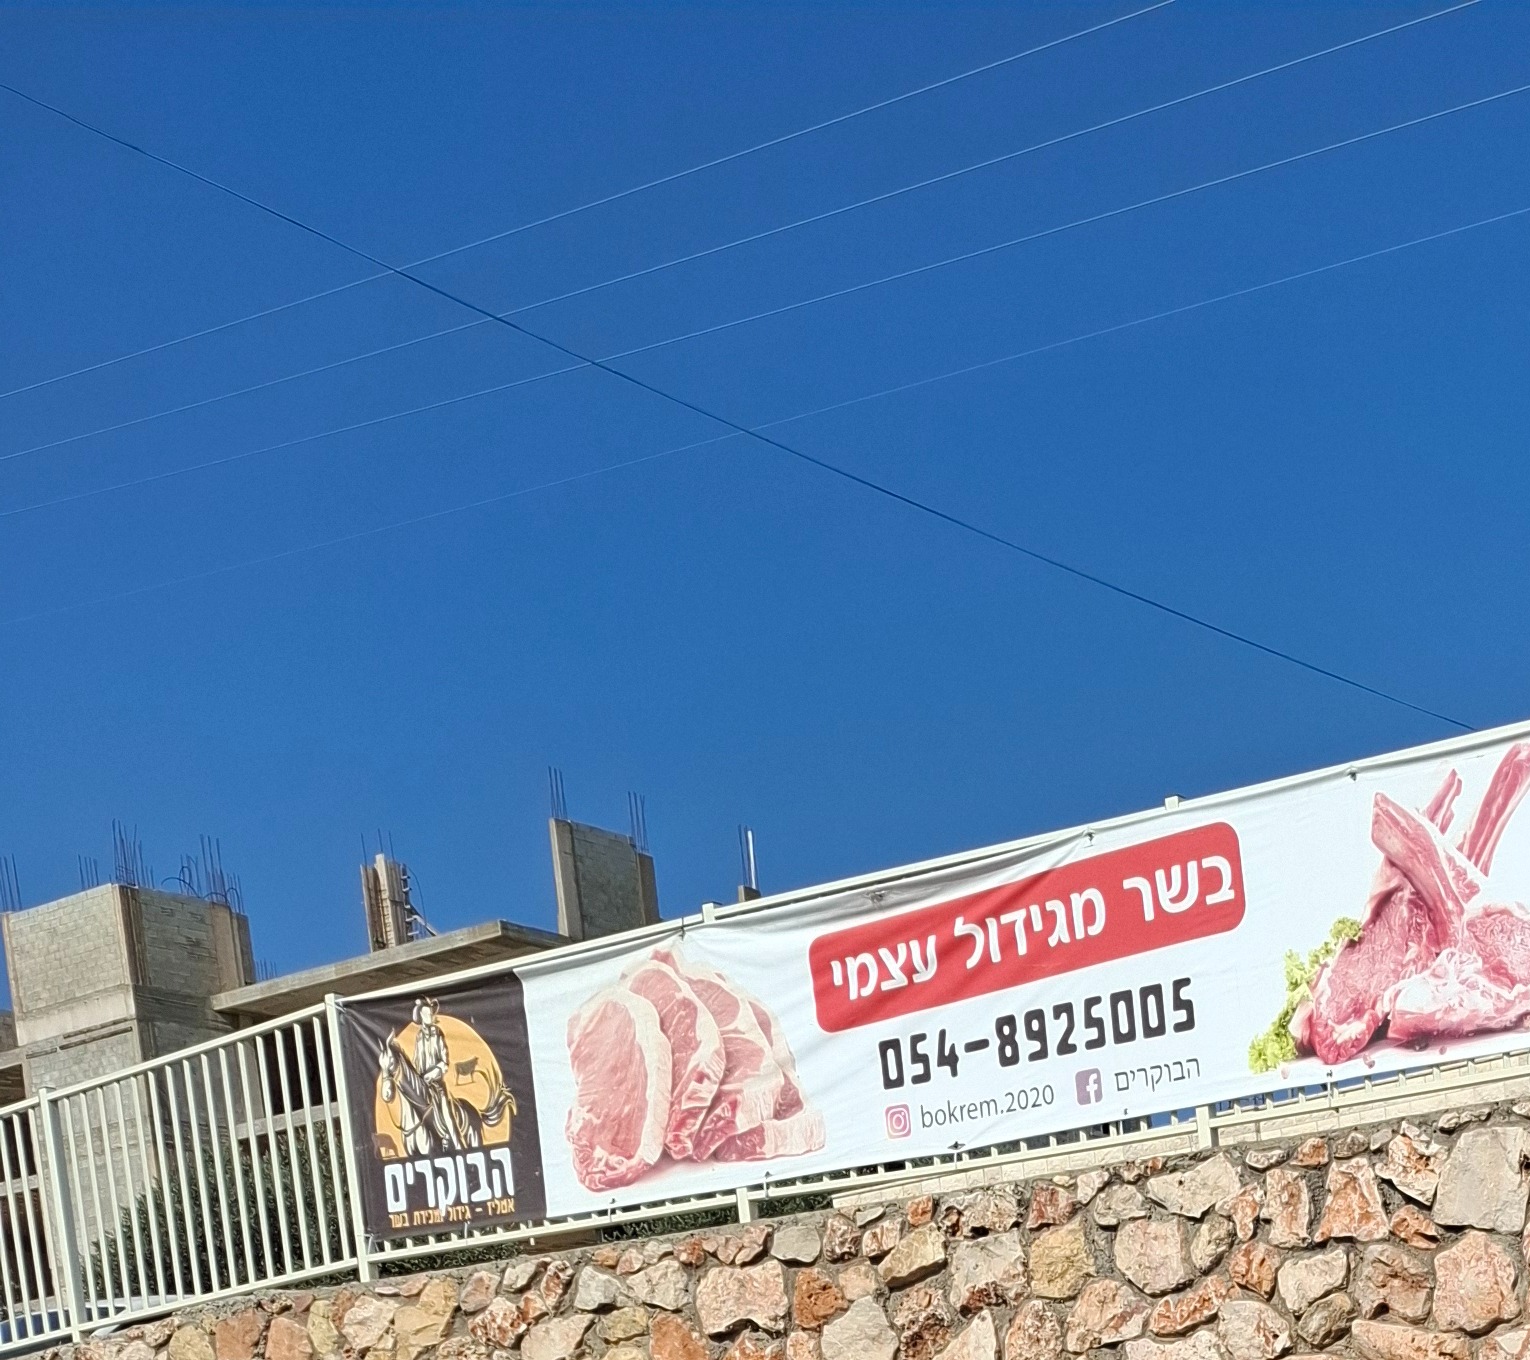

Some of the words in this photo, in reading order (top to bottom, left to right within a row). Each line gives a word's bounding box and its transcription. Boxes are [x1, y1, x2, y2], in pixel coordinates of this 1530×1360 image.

[1123, 855, 1235, 922] בשר
[954, 887, 1106, 970] מגידול
[831, 933, 938, 1001] עצמי
[878, 977, 1195, 1090] 054-8925005
[1114, 1056, 1201, 1093] הבוקרים
[920, 1084, 1055, 1129] bokrem.2020
[384, 1147, 515, 1217] הבוקרים
[487, 1198, 515, 1216] אטליז
[389, 1213, 410, 1228] בשר
[447, 1205, 472, 1221] גידול
